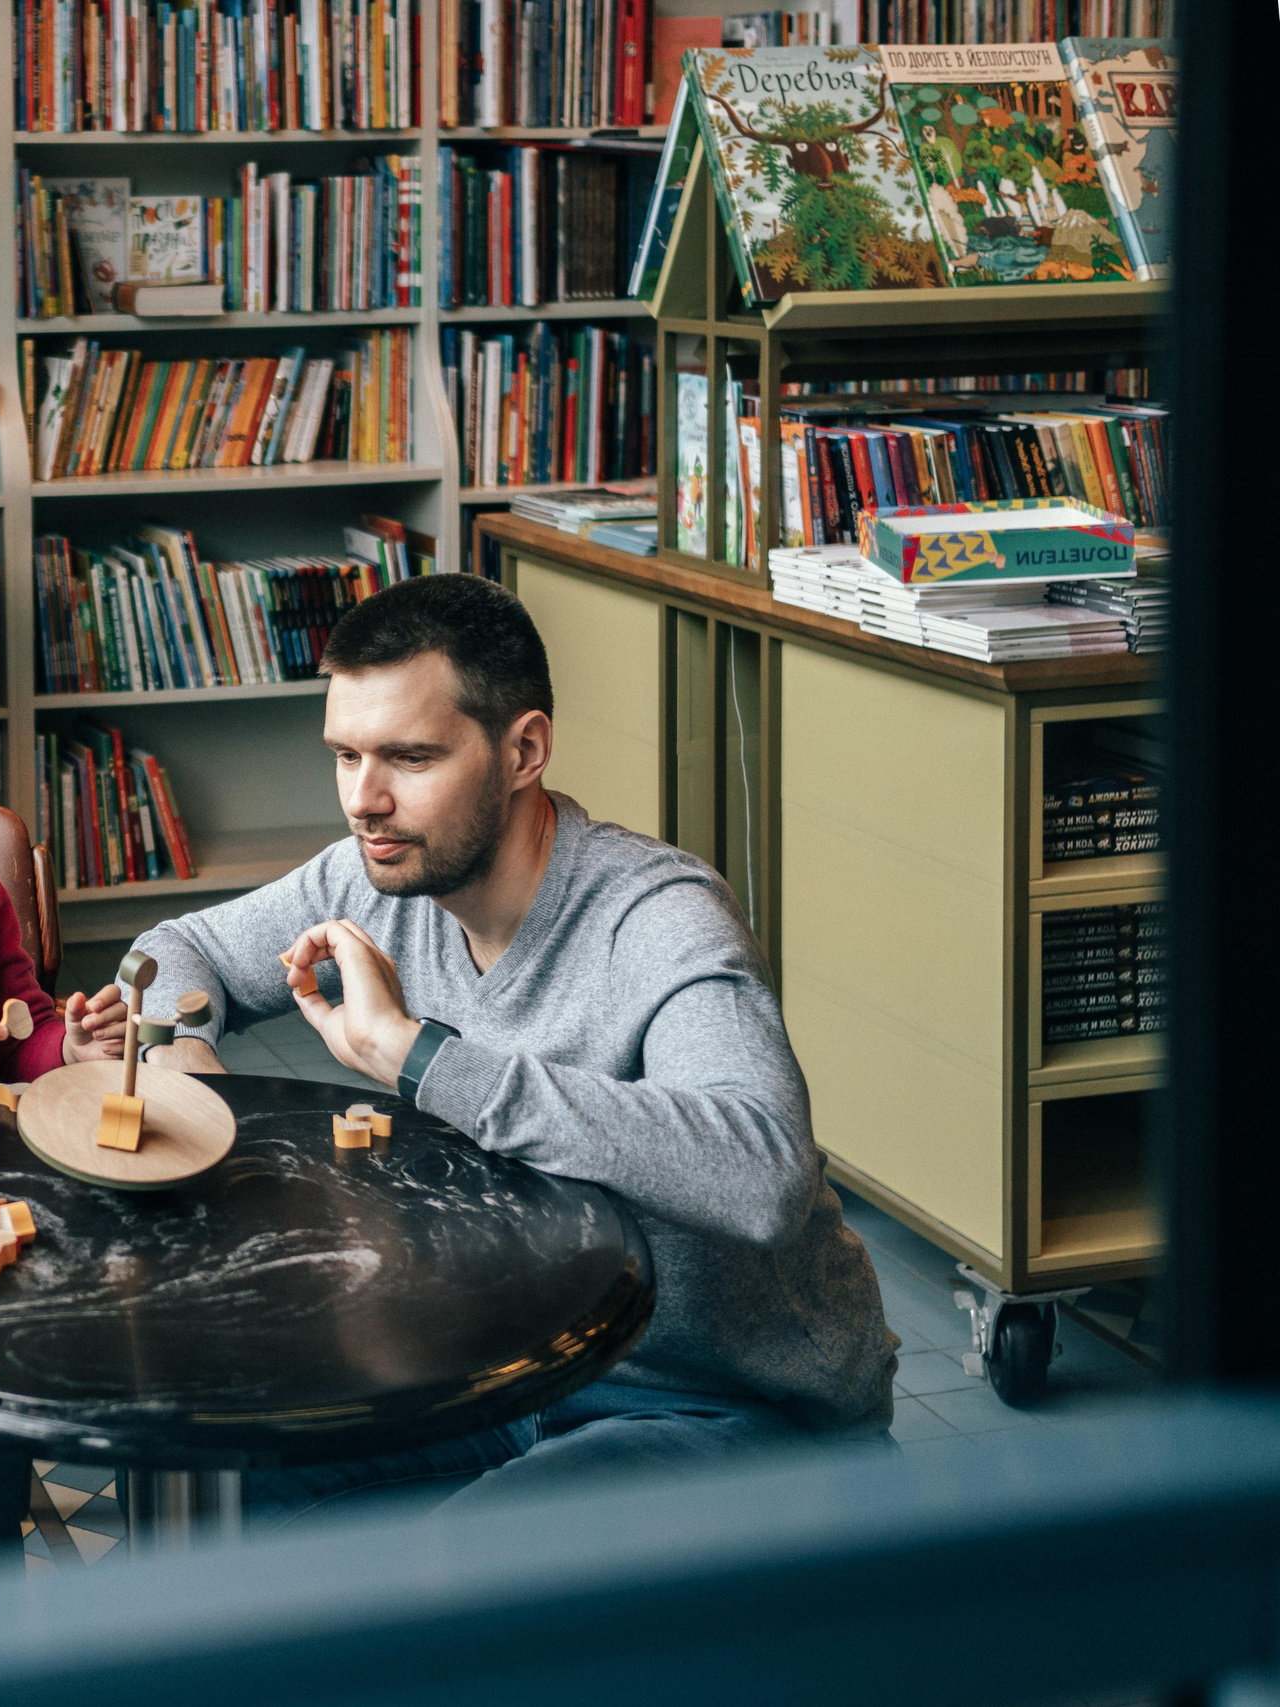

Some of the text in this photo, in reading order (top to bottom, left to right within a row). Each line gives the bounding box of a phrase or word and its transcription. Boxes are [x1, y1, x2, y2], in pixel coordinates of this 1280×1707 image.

[888, 49, 1053, 69] ПО ДОРОГЕ В ЙЕЛЛОУСТОУН
[729, 60, 859, 106] Деревья
[1115, 83, 1177, 117] КАР
[1016, 546, 1128, 566] ПОЛЕТЕЛИ
[1067, 816, 1075, 826] И
[1113, 815, 1160, 829] ХОКИНГ
[1067, 840, 1075, 850] И
[1114, 838, 1161, 853] ХОКИНГ
[1134, 904, 1160, 915] ХОК
[1088, 926, 1095, 935] И
[1136, 927, 1164, 938] ХОК
[1087, 949, 1094, 959] И
[1134, 950, 1166, 961] ХОК
[1088, 973, 1095, 982] И
[1135, 973, 1166, 985] ХОК
[1089, 996, 1096, 1006] И
[1136, 997, 1166, 1008] ХОК
[1091, 1020, 1098, 1030] И
[1137, 1020, 1167, 1032] ХОК
